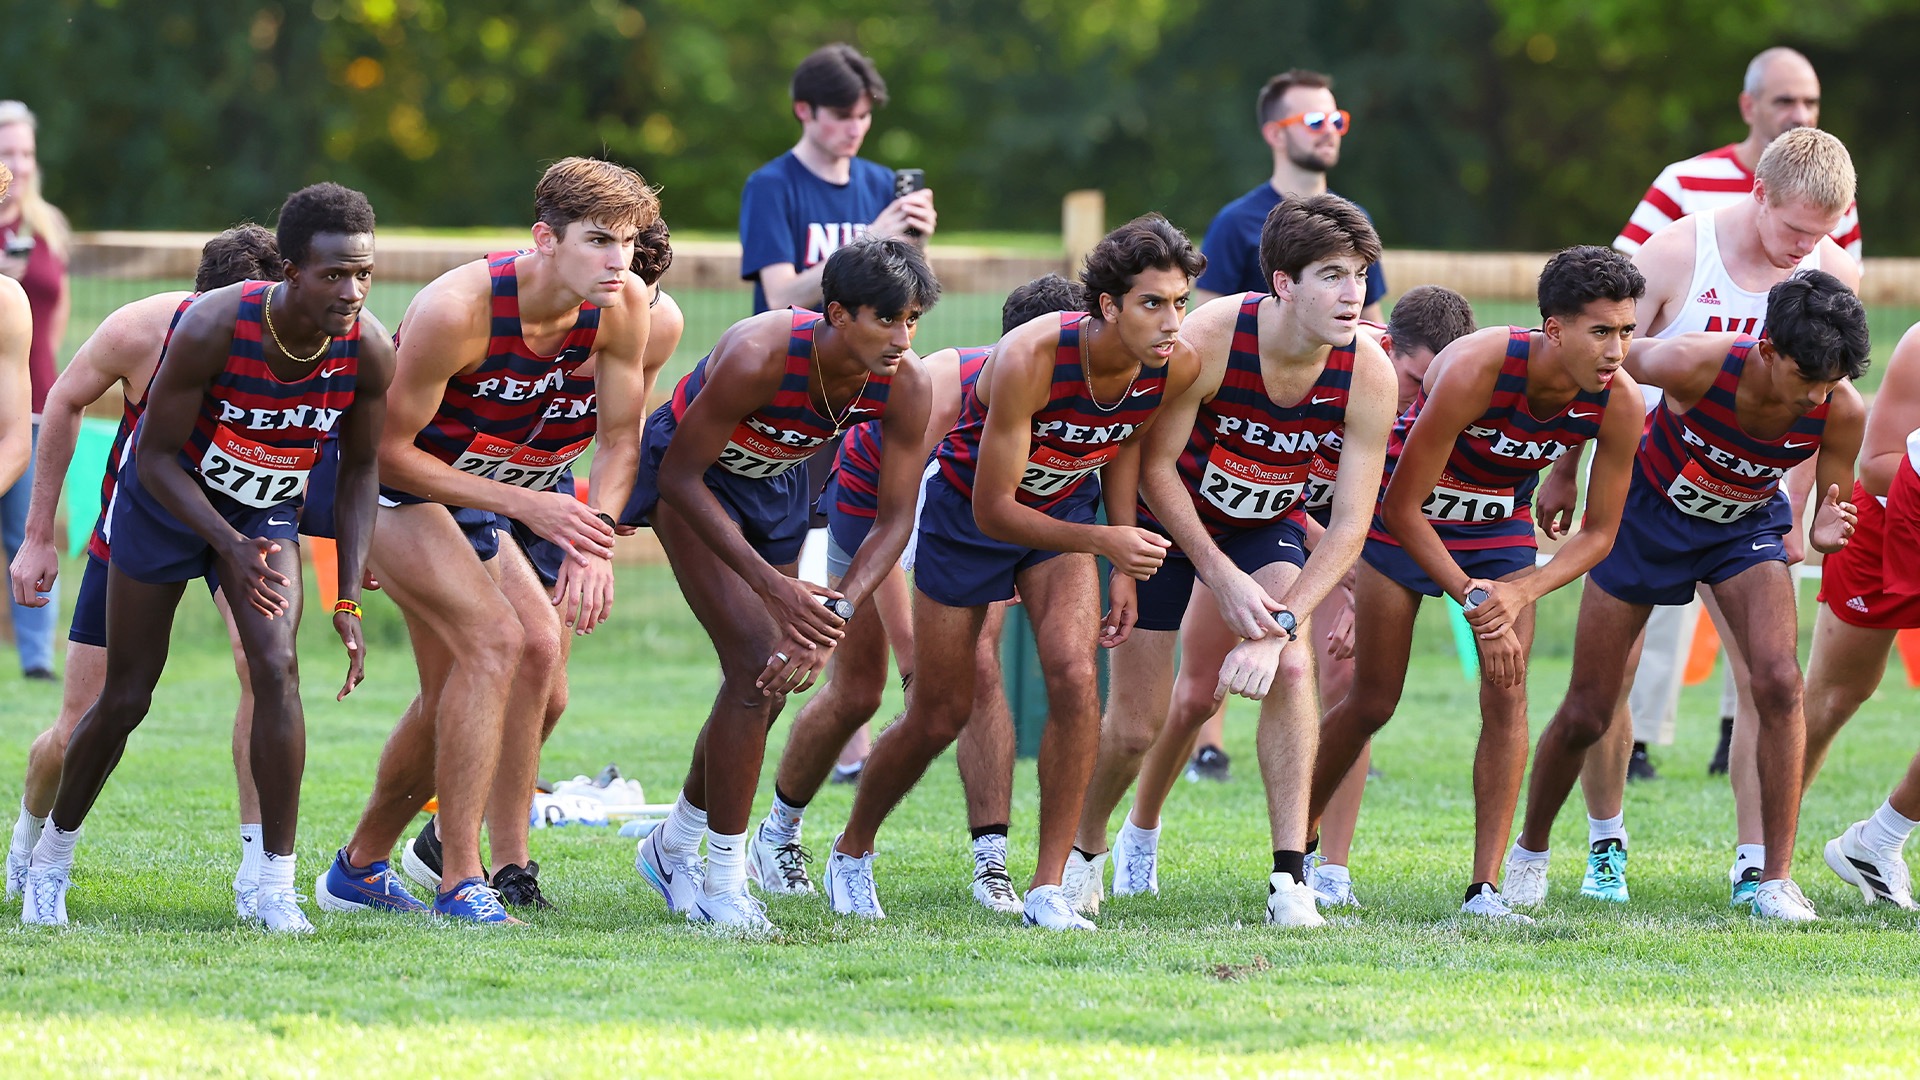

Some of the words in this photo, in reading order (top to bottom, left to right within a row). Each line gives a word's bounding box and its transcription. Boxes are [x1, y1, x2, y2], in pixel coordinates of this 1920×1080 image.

[1697, 297, 1721, 305] adidas
[219, 400, 342, 432] PENN
[746, 437, 770, 453] RACE
[1215, 414, 1326, 454] PENN
[227, 440, 253, 457] RACE
[264, 453, 300, 465] RESULT
[486, 444, 511, 455] RACE
[523, 454, 548, 463] RACE
[1048, 456, 1072, 467] RACE
[1224, 458, 1249, 475] RACE
[1261, 471, 1295, 480] RESULT
[204, 455, 299, 502] 2712
[1696, 475, 1720, 491] RACE
[1206, 472, 1295, 513] 2716
[1421, 491, 1505, 522] 2719
